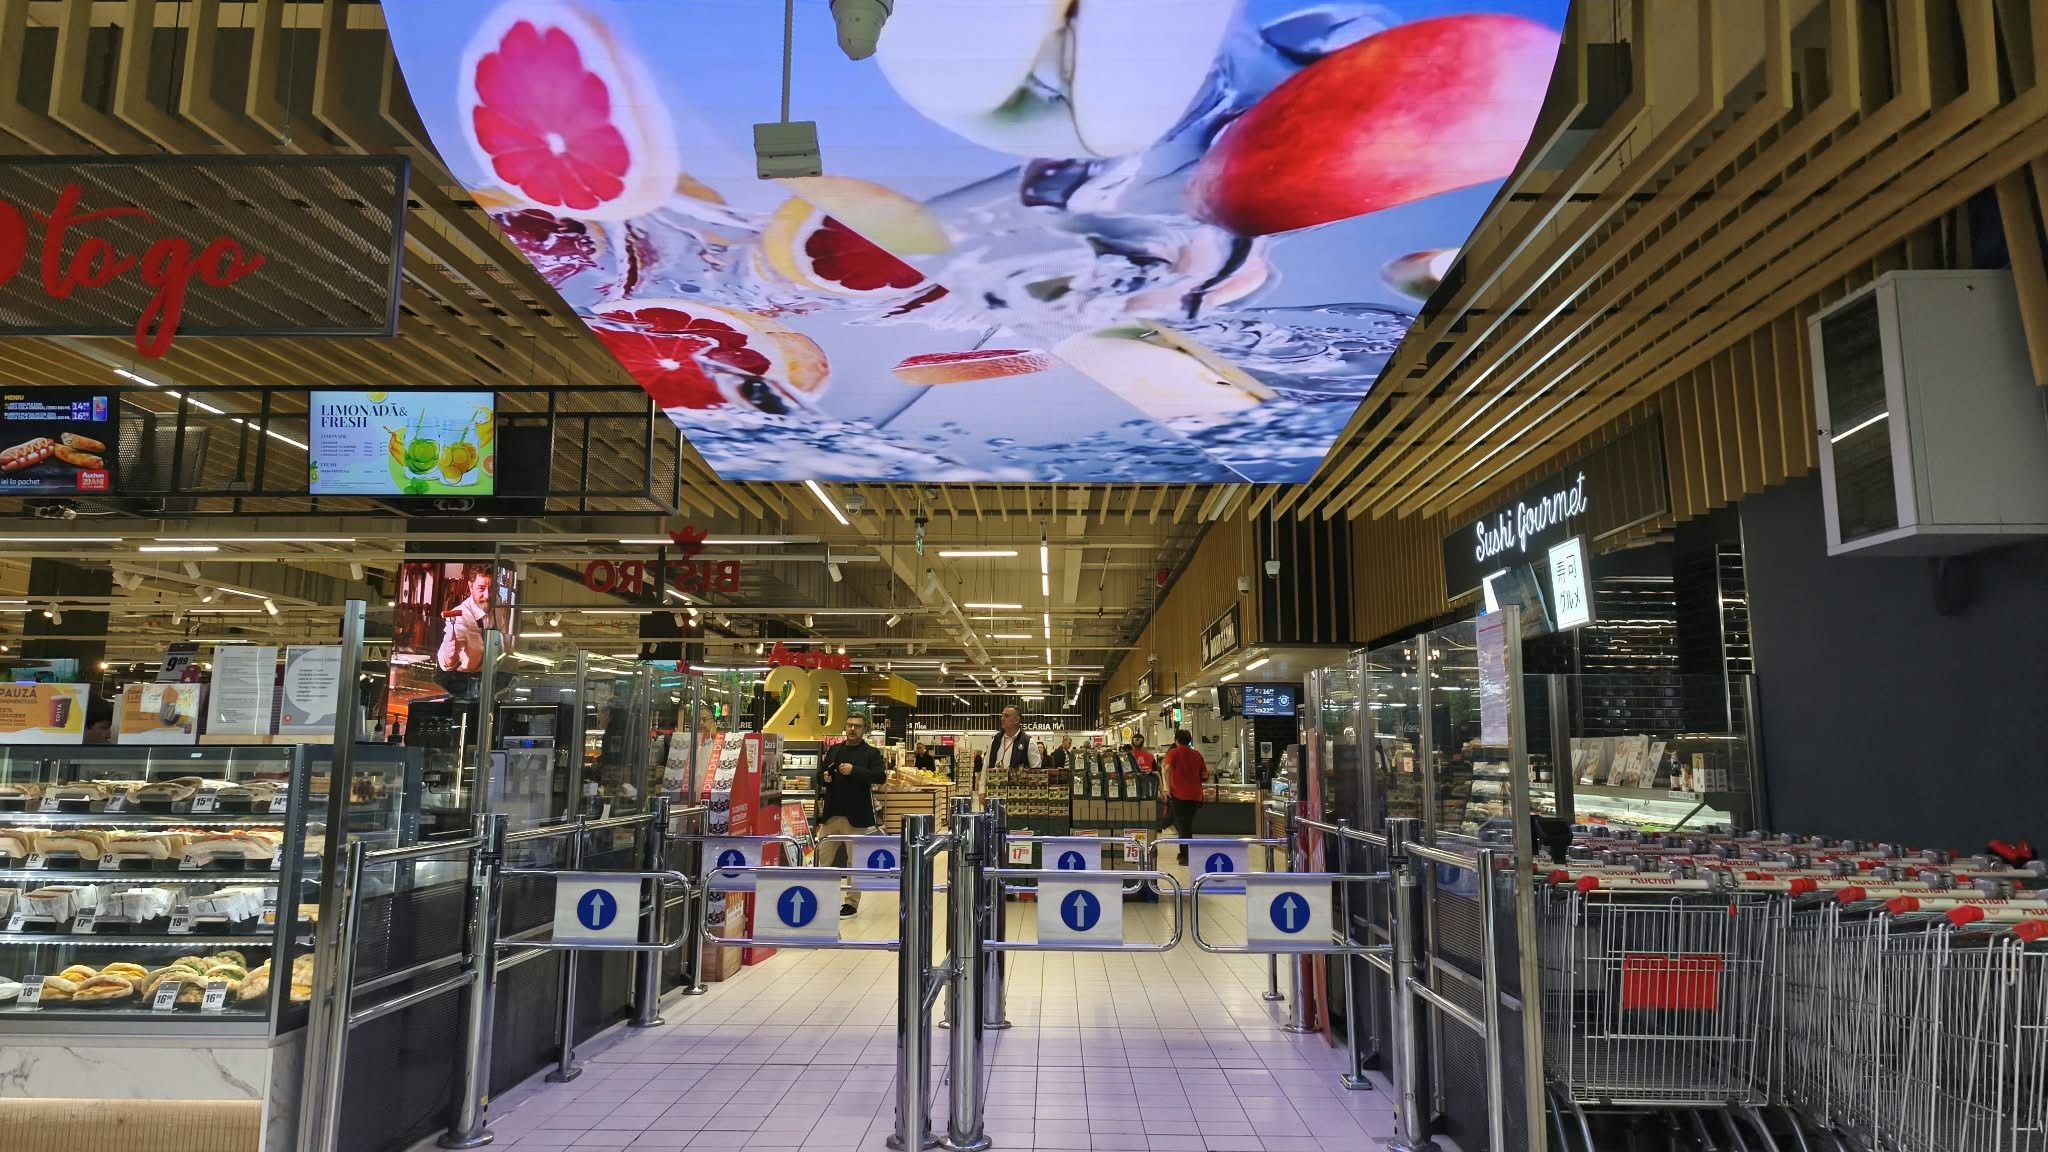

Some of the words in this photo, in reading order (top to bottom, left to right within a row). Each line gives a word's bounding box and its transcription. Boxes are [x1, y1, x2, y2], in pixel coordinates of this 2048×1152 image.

[31, 183, 157, 300] to
[136, 236, 266, 359] go
[321, 417, 367, 428] FRESH
[1476, 509, 1516, 562] Sushi
[1517, 471, 1588, 552] Gourmet
[1556, 554, 1577, 584] 寿司
[763, 665, 848, 738] 20
[1020, 721, 1051, 730] ESCĂRIA
